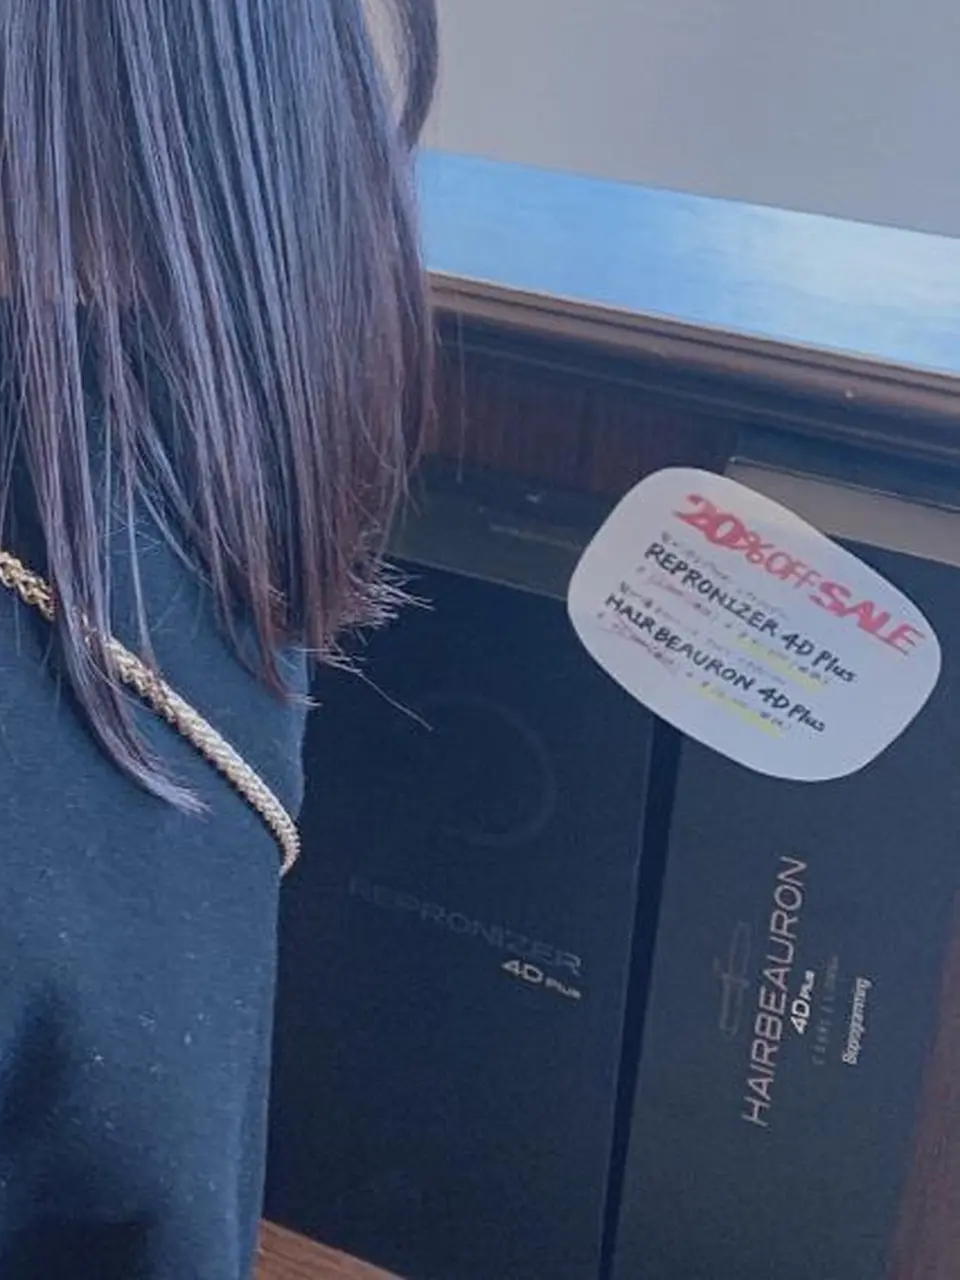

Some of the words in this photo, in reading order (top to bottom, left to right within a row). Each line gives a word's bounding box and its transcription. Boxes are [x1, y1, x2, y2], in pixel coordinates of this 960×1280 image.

[644, 542, 779, 637] REPRONIZER
[816, 651, 857, 683] Plus
[810, 580, 924, 656] SALE
[790, 704, 825, 732] Plus
[501, 960, 543, 983] 4D
[742, 855, 807, 1127] HAIRBEAURON
[791, 999, 810, 1035] 4D
